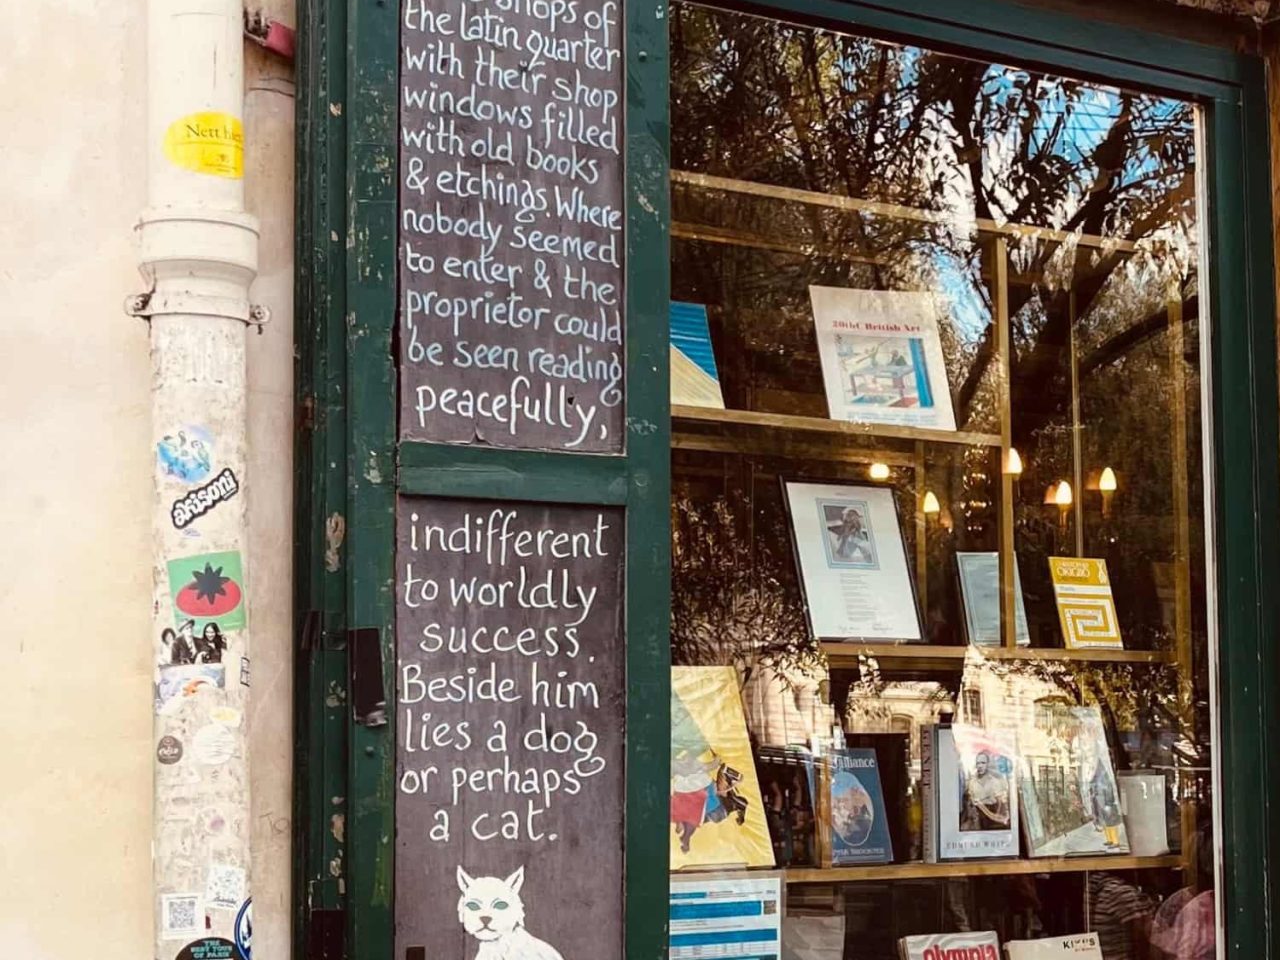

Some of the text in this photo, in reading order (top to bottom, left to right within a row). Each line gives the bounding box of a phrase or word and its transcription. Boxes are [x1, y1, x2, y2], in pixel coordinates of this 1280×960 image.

[460, 3, 522, 52] latin
[526, 30, 620, 71] quarter
[584, 1, 617, 48] of
[406, 40, 618, 124] with their shop
[185, 123, 220, 138] Nett
[403, 115, 599, 184] with old books
[404, 82, 619, 155] windows filled
[405, 158, 622, 230] & etchings. Where
[403, 201, 620, 268] nobody seemed
[405, 242, 616, 305] to enter & the
[406, 289, 622, 345] proprietor could
[408, 325, 622, 407] be seen reading
[415, 376, 608, 448] peacefully,
[411, 508, 610, 566] indifferent
[404, 563, 597, 627] to worldly
[420, 622, 595, 663] success.
[400, 661, 600, 709] Beside him
[405, 708, 606, 777] lies a dog
[400, 755, 582, 808] or perhaps
[429, 800, 558, 842] a cat.
